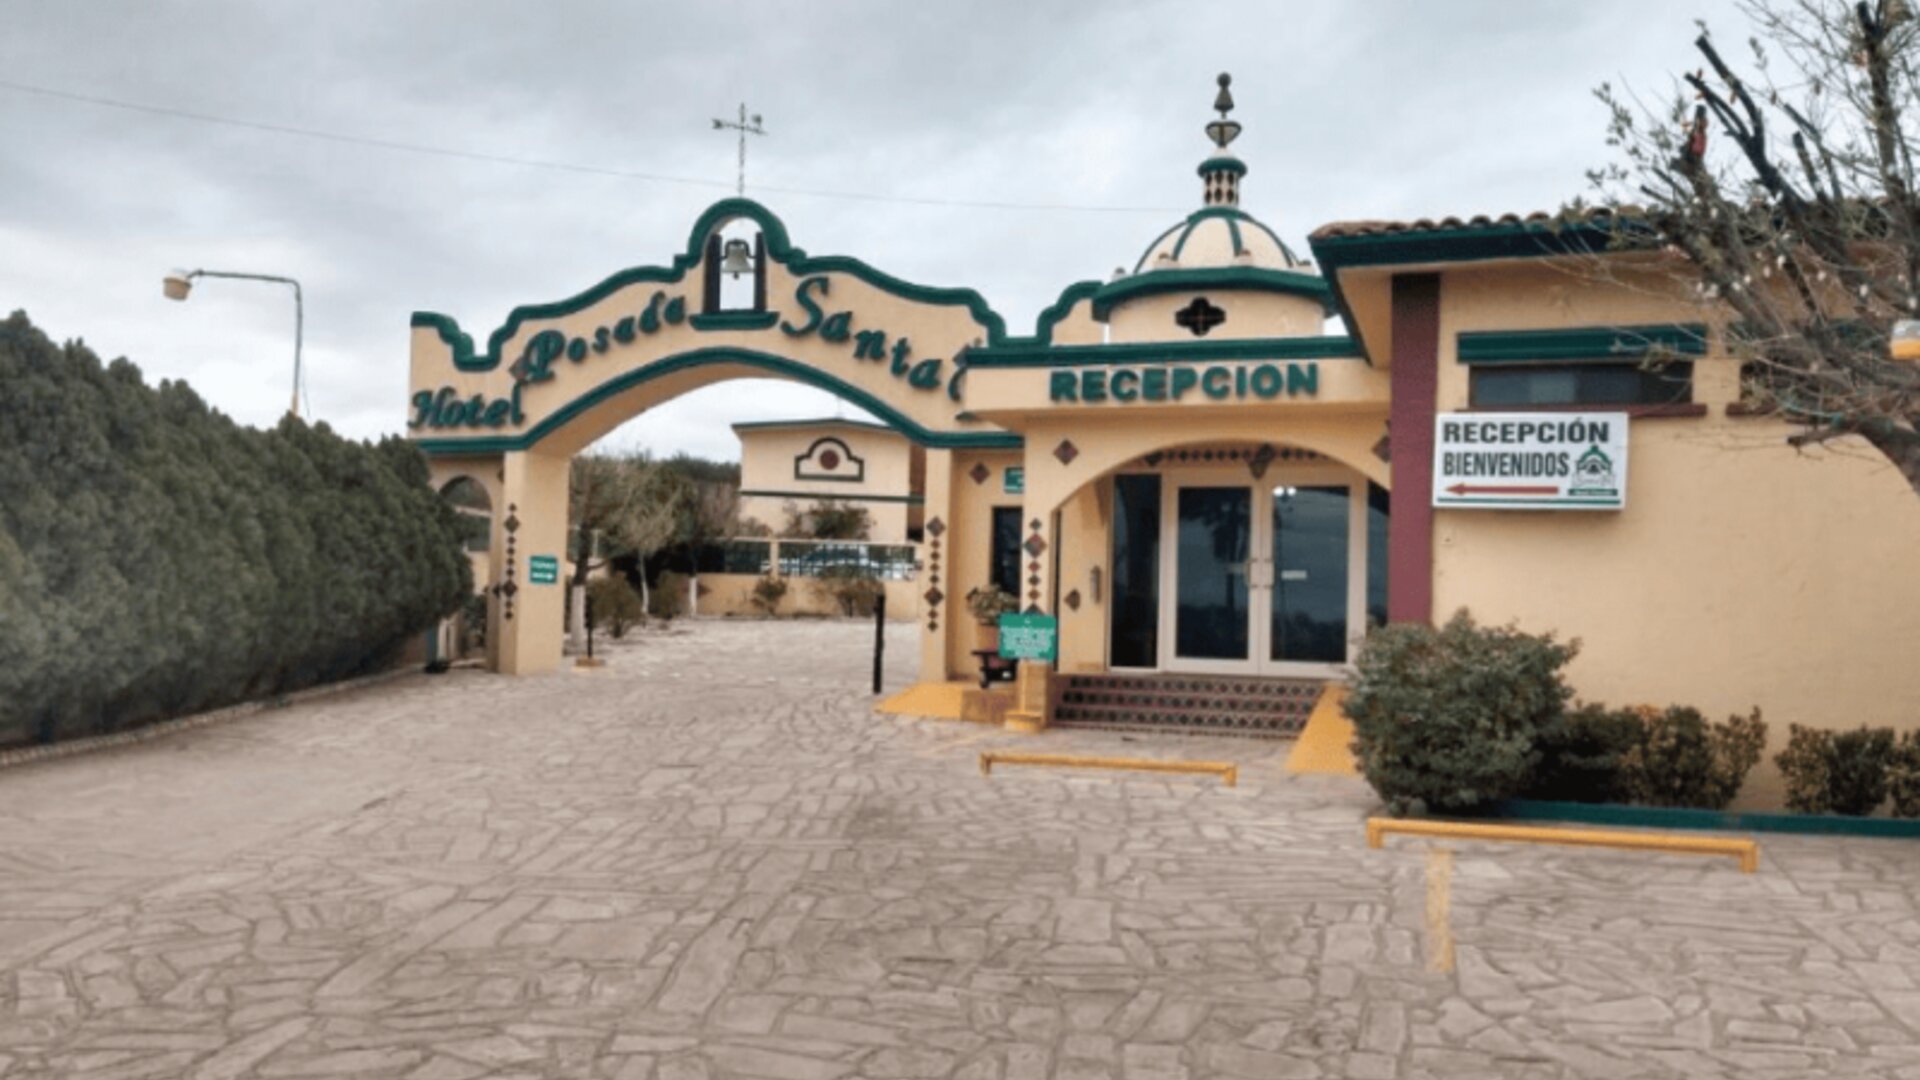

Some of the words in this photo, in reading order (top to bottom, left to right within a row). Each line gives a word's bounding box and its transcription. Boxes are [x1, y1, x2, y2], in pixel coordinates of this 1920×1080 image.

[407, 380, 524, 429] Hotel
[519, 290, 686, 384] Posada
[780, 276, 942, 391] Santa
[1050, 363, 1318, 404] RECEPCION
[1443, 417, 1609, 444] RECEPCIÓN
[1443, 452, 1570, 477] BIENVENIDOS
